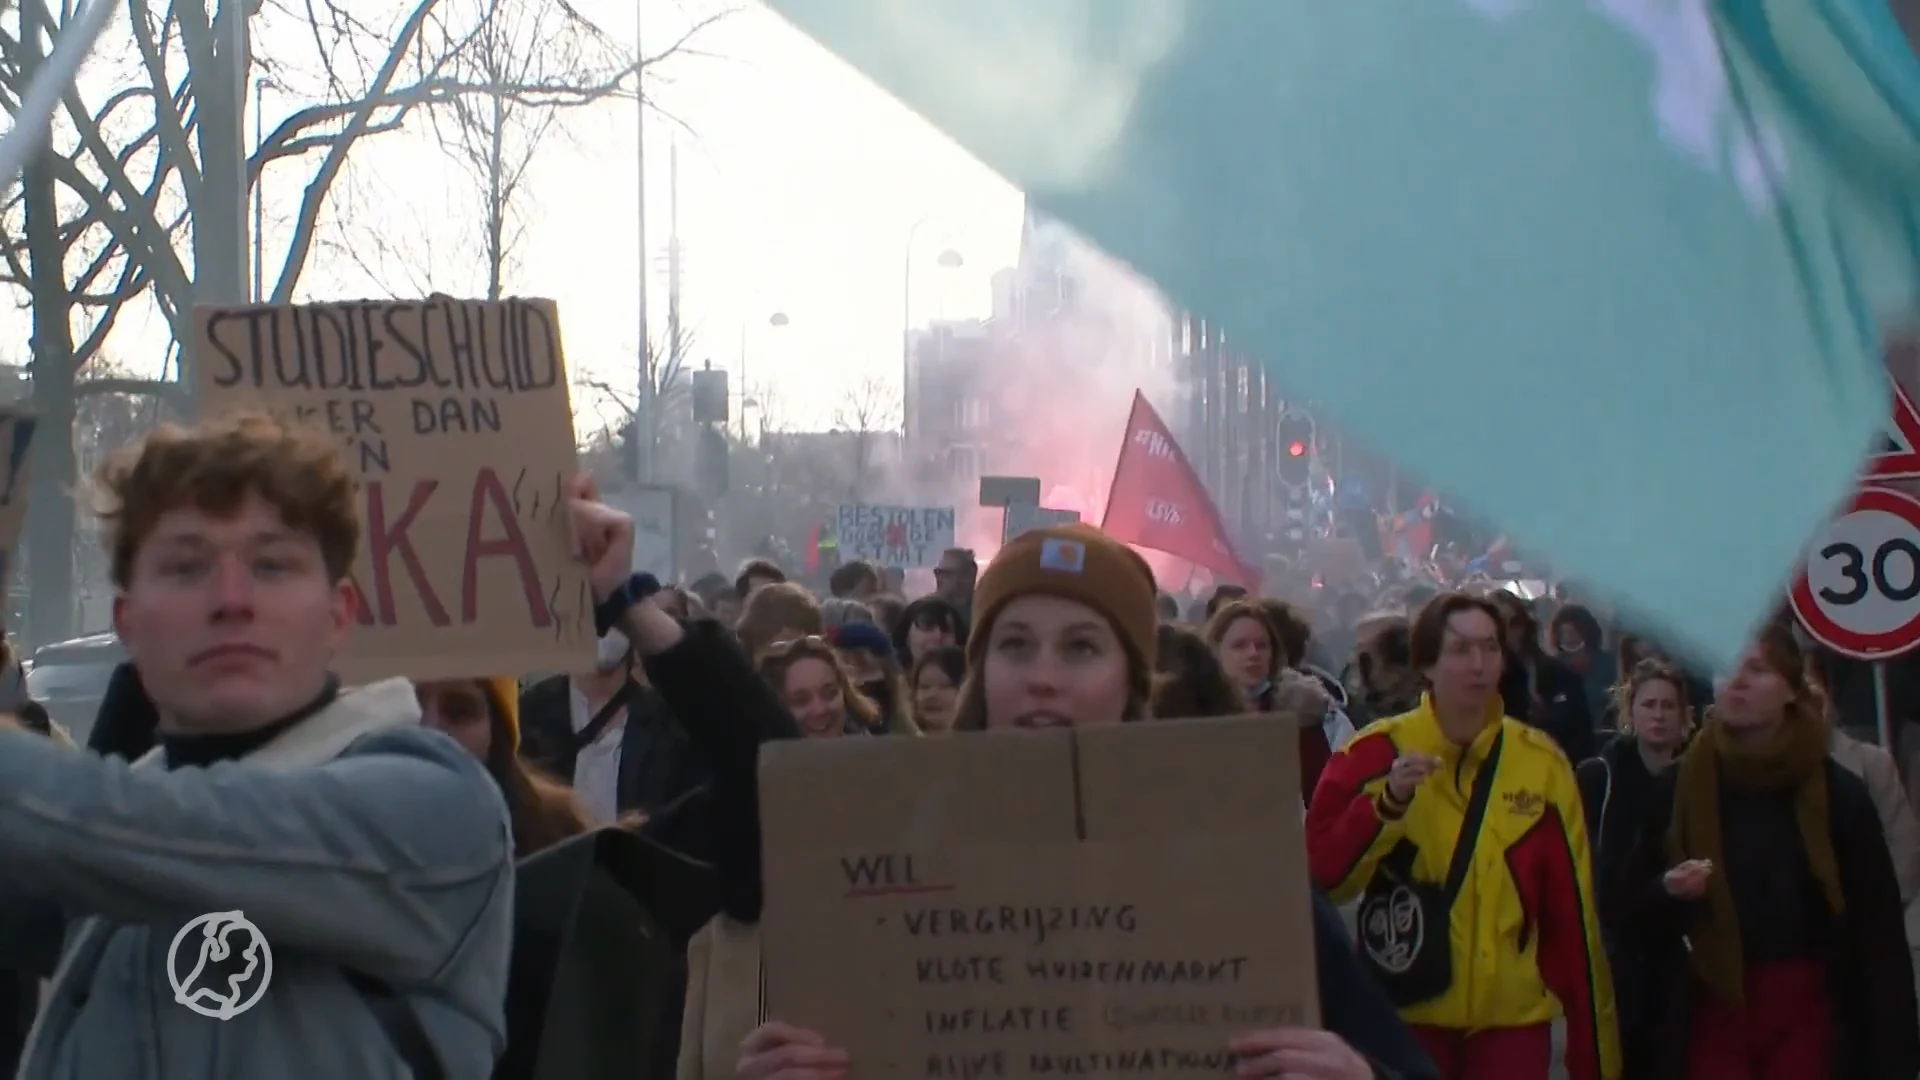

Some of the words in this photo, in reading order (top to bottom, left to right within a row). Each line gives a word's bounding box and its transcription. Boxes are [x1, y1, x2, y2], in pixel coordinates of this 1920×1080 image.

[207, 302, 557, 393] STUDIESCHULD
[413, 397, 501, 435] DAN
[839, 505, 954, 530] BESTOLEN
[354, 467, 552, 628] KA
[1819, 538, 1920, 605] 30
[903, 904, 1137, 945] VERGRIJZING
[916, 955, 1010, 985] KLOTE
[925, 1004, 1073, 1035] INFLATIE
[1029, 1049, 1239, 1075] MULTINATIONA
